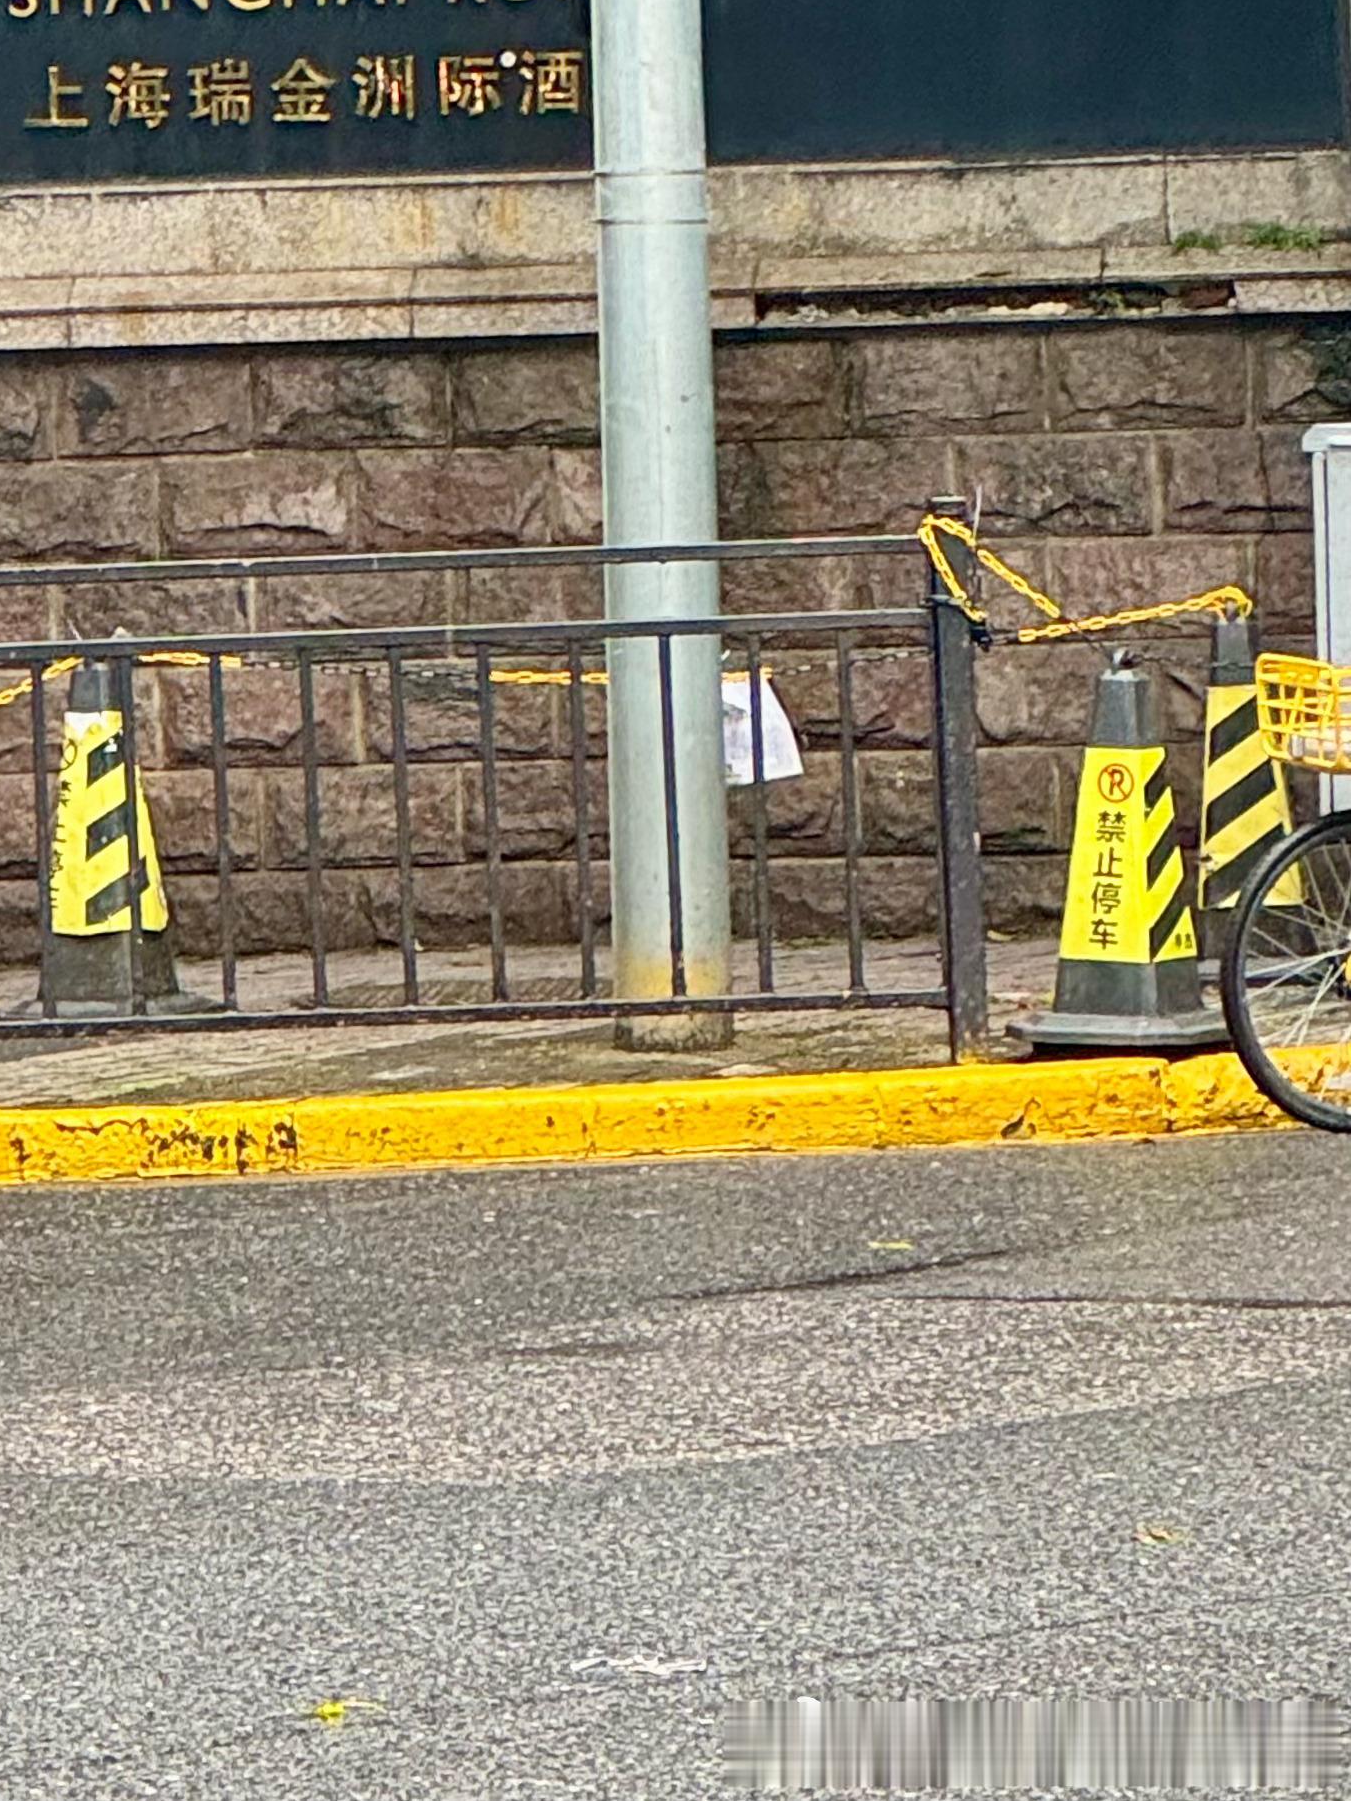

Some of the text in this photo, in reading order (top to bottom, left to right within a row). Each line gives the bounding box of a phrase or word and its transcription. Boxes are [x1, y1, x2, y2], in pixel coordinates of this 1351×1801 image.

[23, 49, 583, 130] 上海瑞金洲际酒
[1088, 810, 1127, 950] 禁止停车
